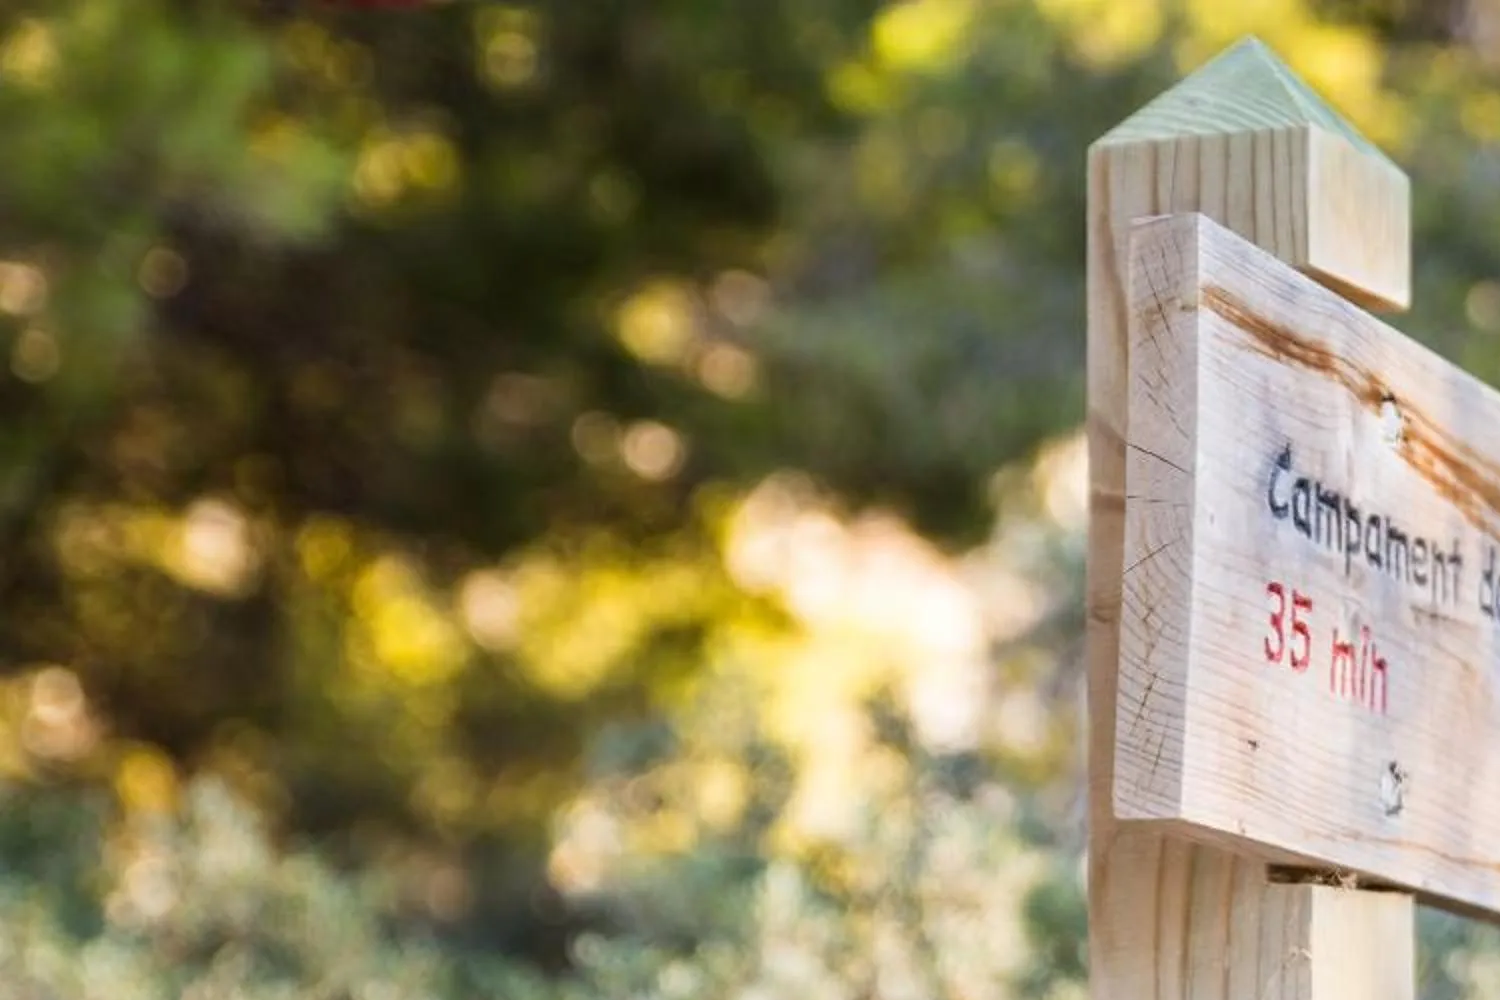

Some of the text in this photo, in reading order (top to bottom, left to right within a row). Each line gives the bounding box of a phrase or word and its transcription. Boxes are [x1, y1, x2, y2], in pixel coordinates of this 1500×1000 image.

[1267, 442, 1463, 602] Campament
[1264, 580, 1389, 715] 35 min
